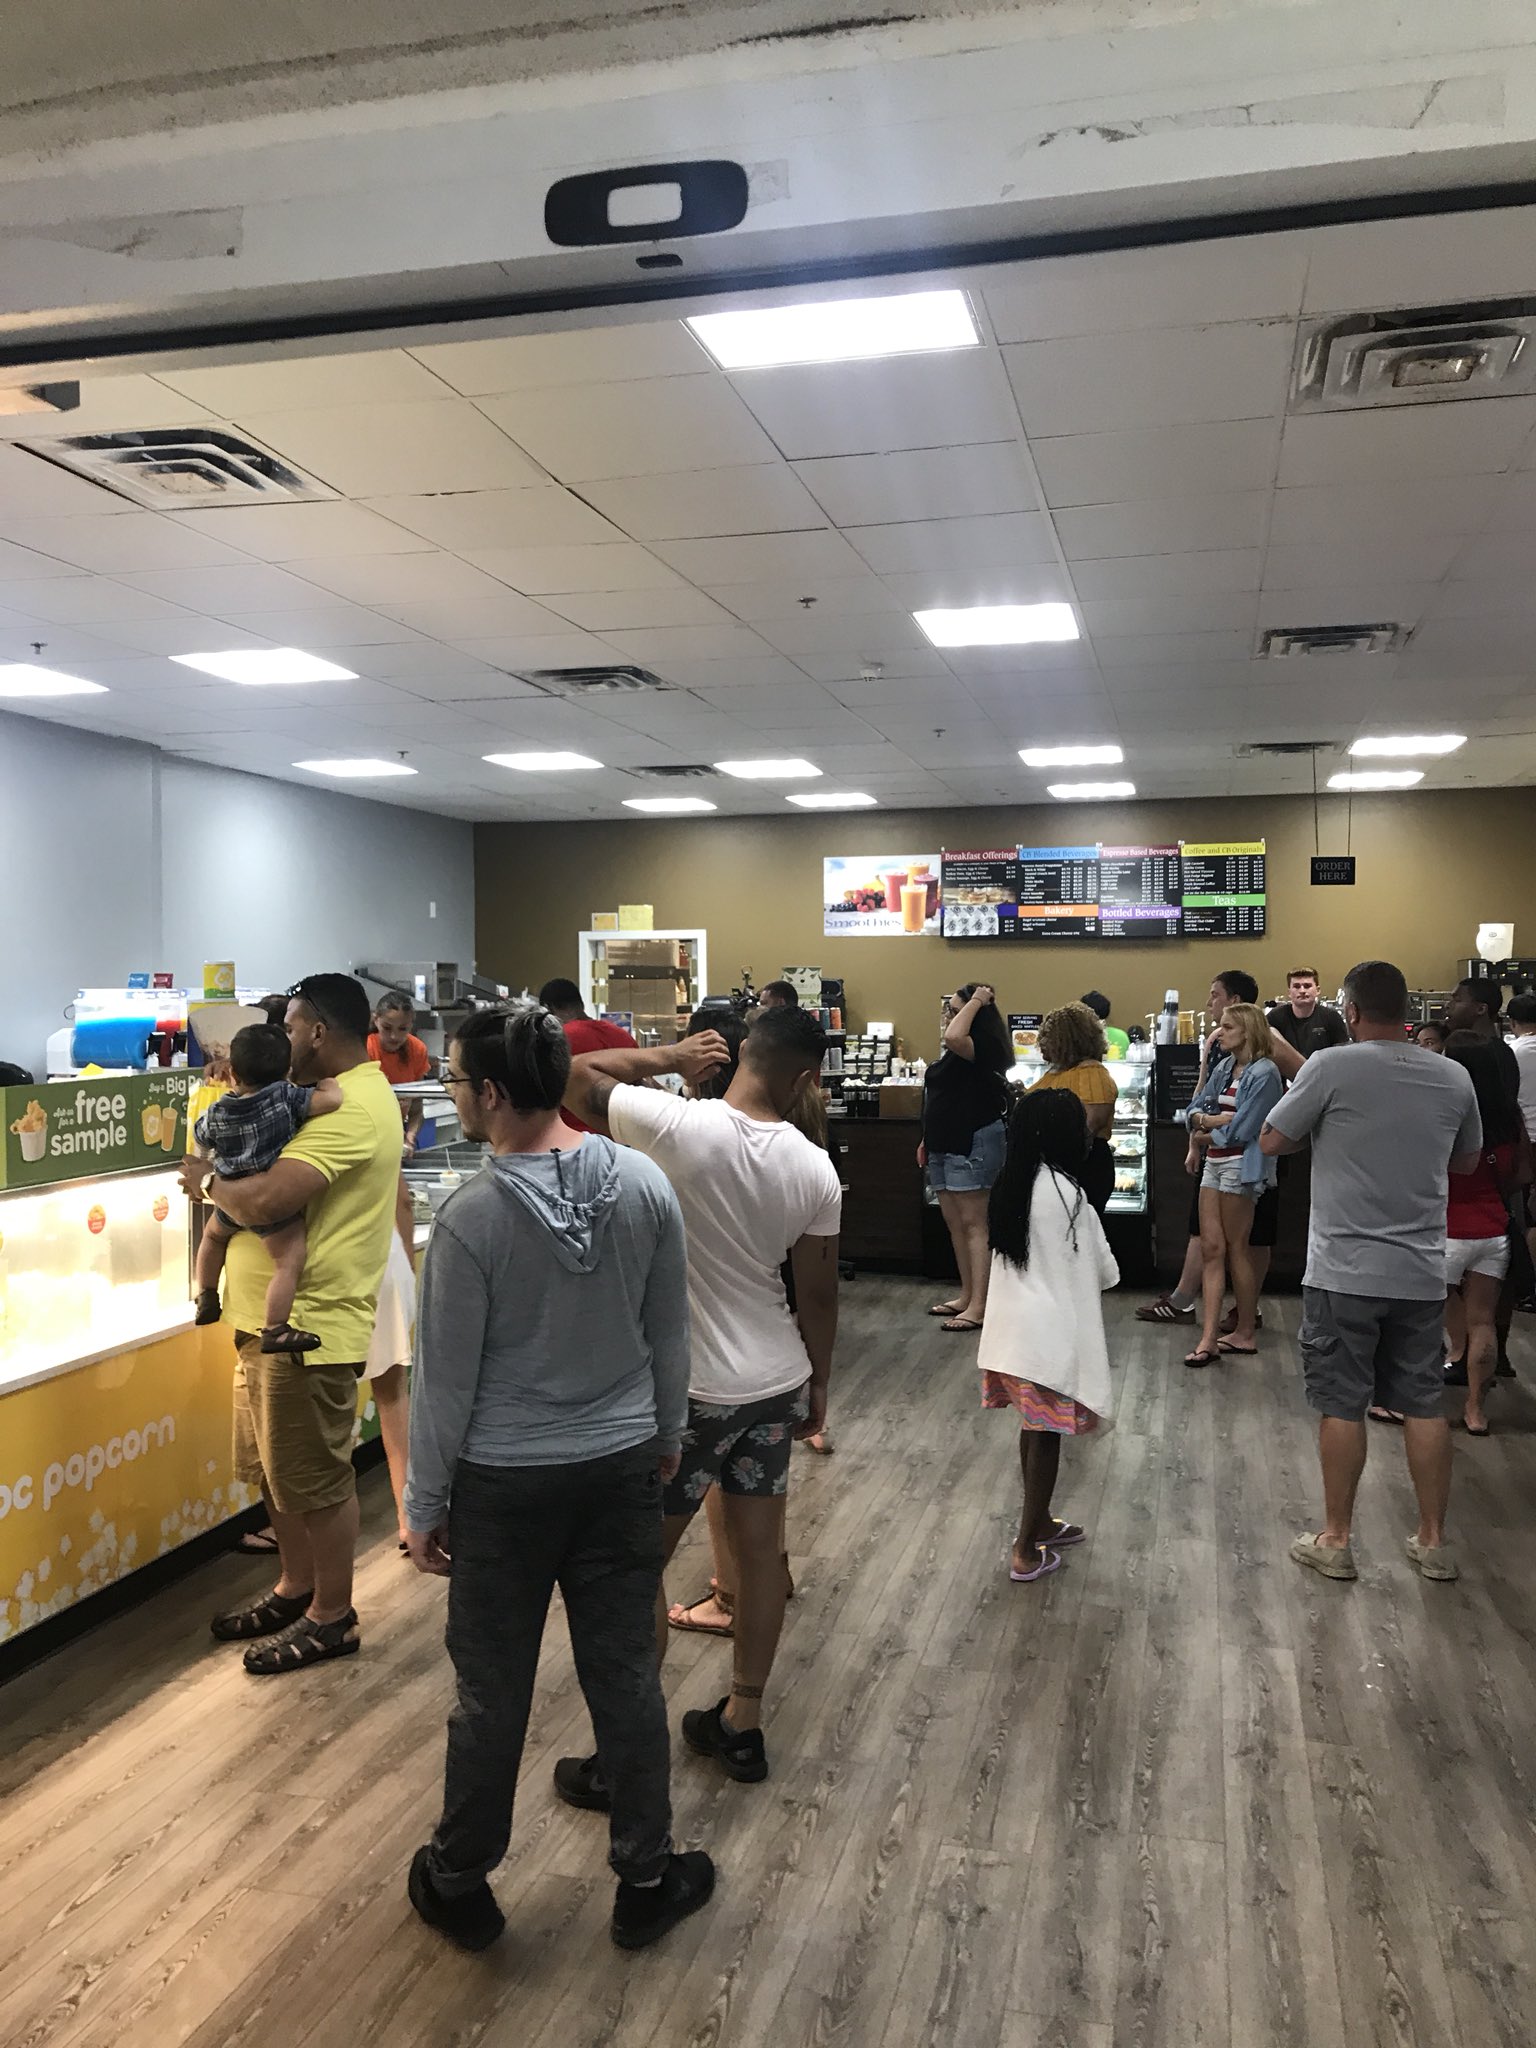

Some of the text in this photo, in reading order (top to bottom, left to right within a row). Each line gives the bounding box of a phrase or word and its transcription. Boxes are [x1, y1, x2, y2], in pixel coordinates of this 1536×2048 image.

[945, 850, 1018, 861] Breakfast Offerings
[1034, 850, 1060, 859] Blended
[1062, 849, 1097, 859] Beverages
[1103, 847, 1178, 858] Espresso Based Beverages
[1185, 845, 1263, 855] Coffee and CB Originals
[1315, 861, 1351, 871] ORDER
[1319, 872, 1348, 881] HERE
[1212, 895, 1237, 906] Teas
[1044, 905, 1074, 917] Bakery
[1102, 907, 1133, 918] Bottled
[1135, 907, 1179, 918] Beverages
[166, 1076, 187, 1096] Big
[75, 1089, 127, 1125] free
[50, 1120, 127, 1156] sample
[43, 1415, 176, 1512] popcorn
